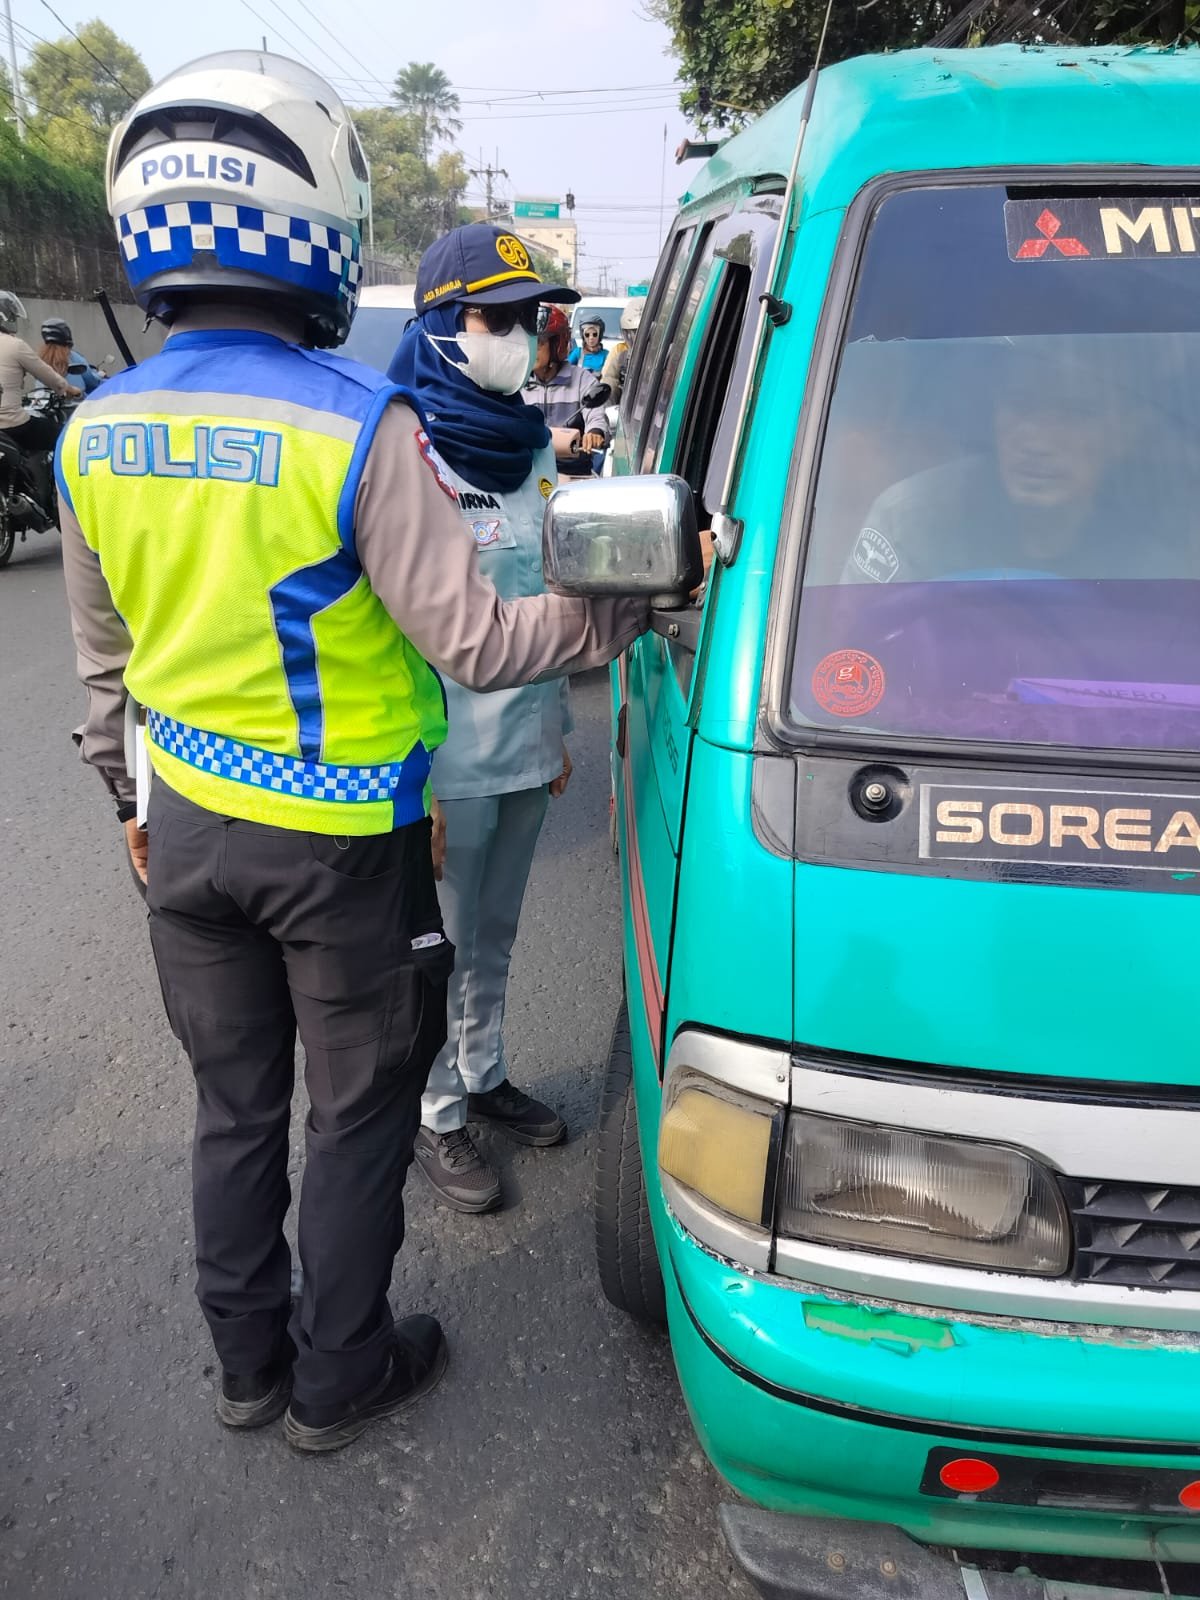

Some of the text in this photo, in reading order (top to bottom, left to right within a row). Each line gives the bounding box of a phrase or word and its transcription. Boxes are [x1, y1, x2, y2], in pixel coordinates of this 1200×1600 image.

[141, 154, 256, 187] POLISI
[79, 422, 283, 487] POLISI
[456, 492, 501, 510] IRNA
[936, 800, 1200, 853] SOREA
